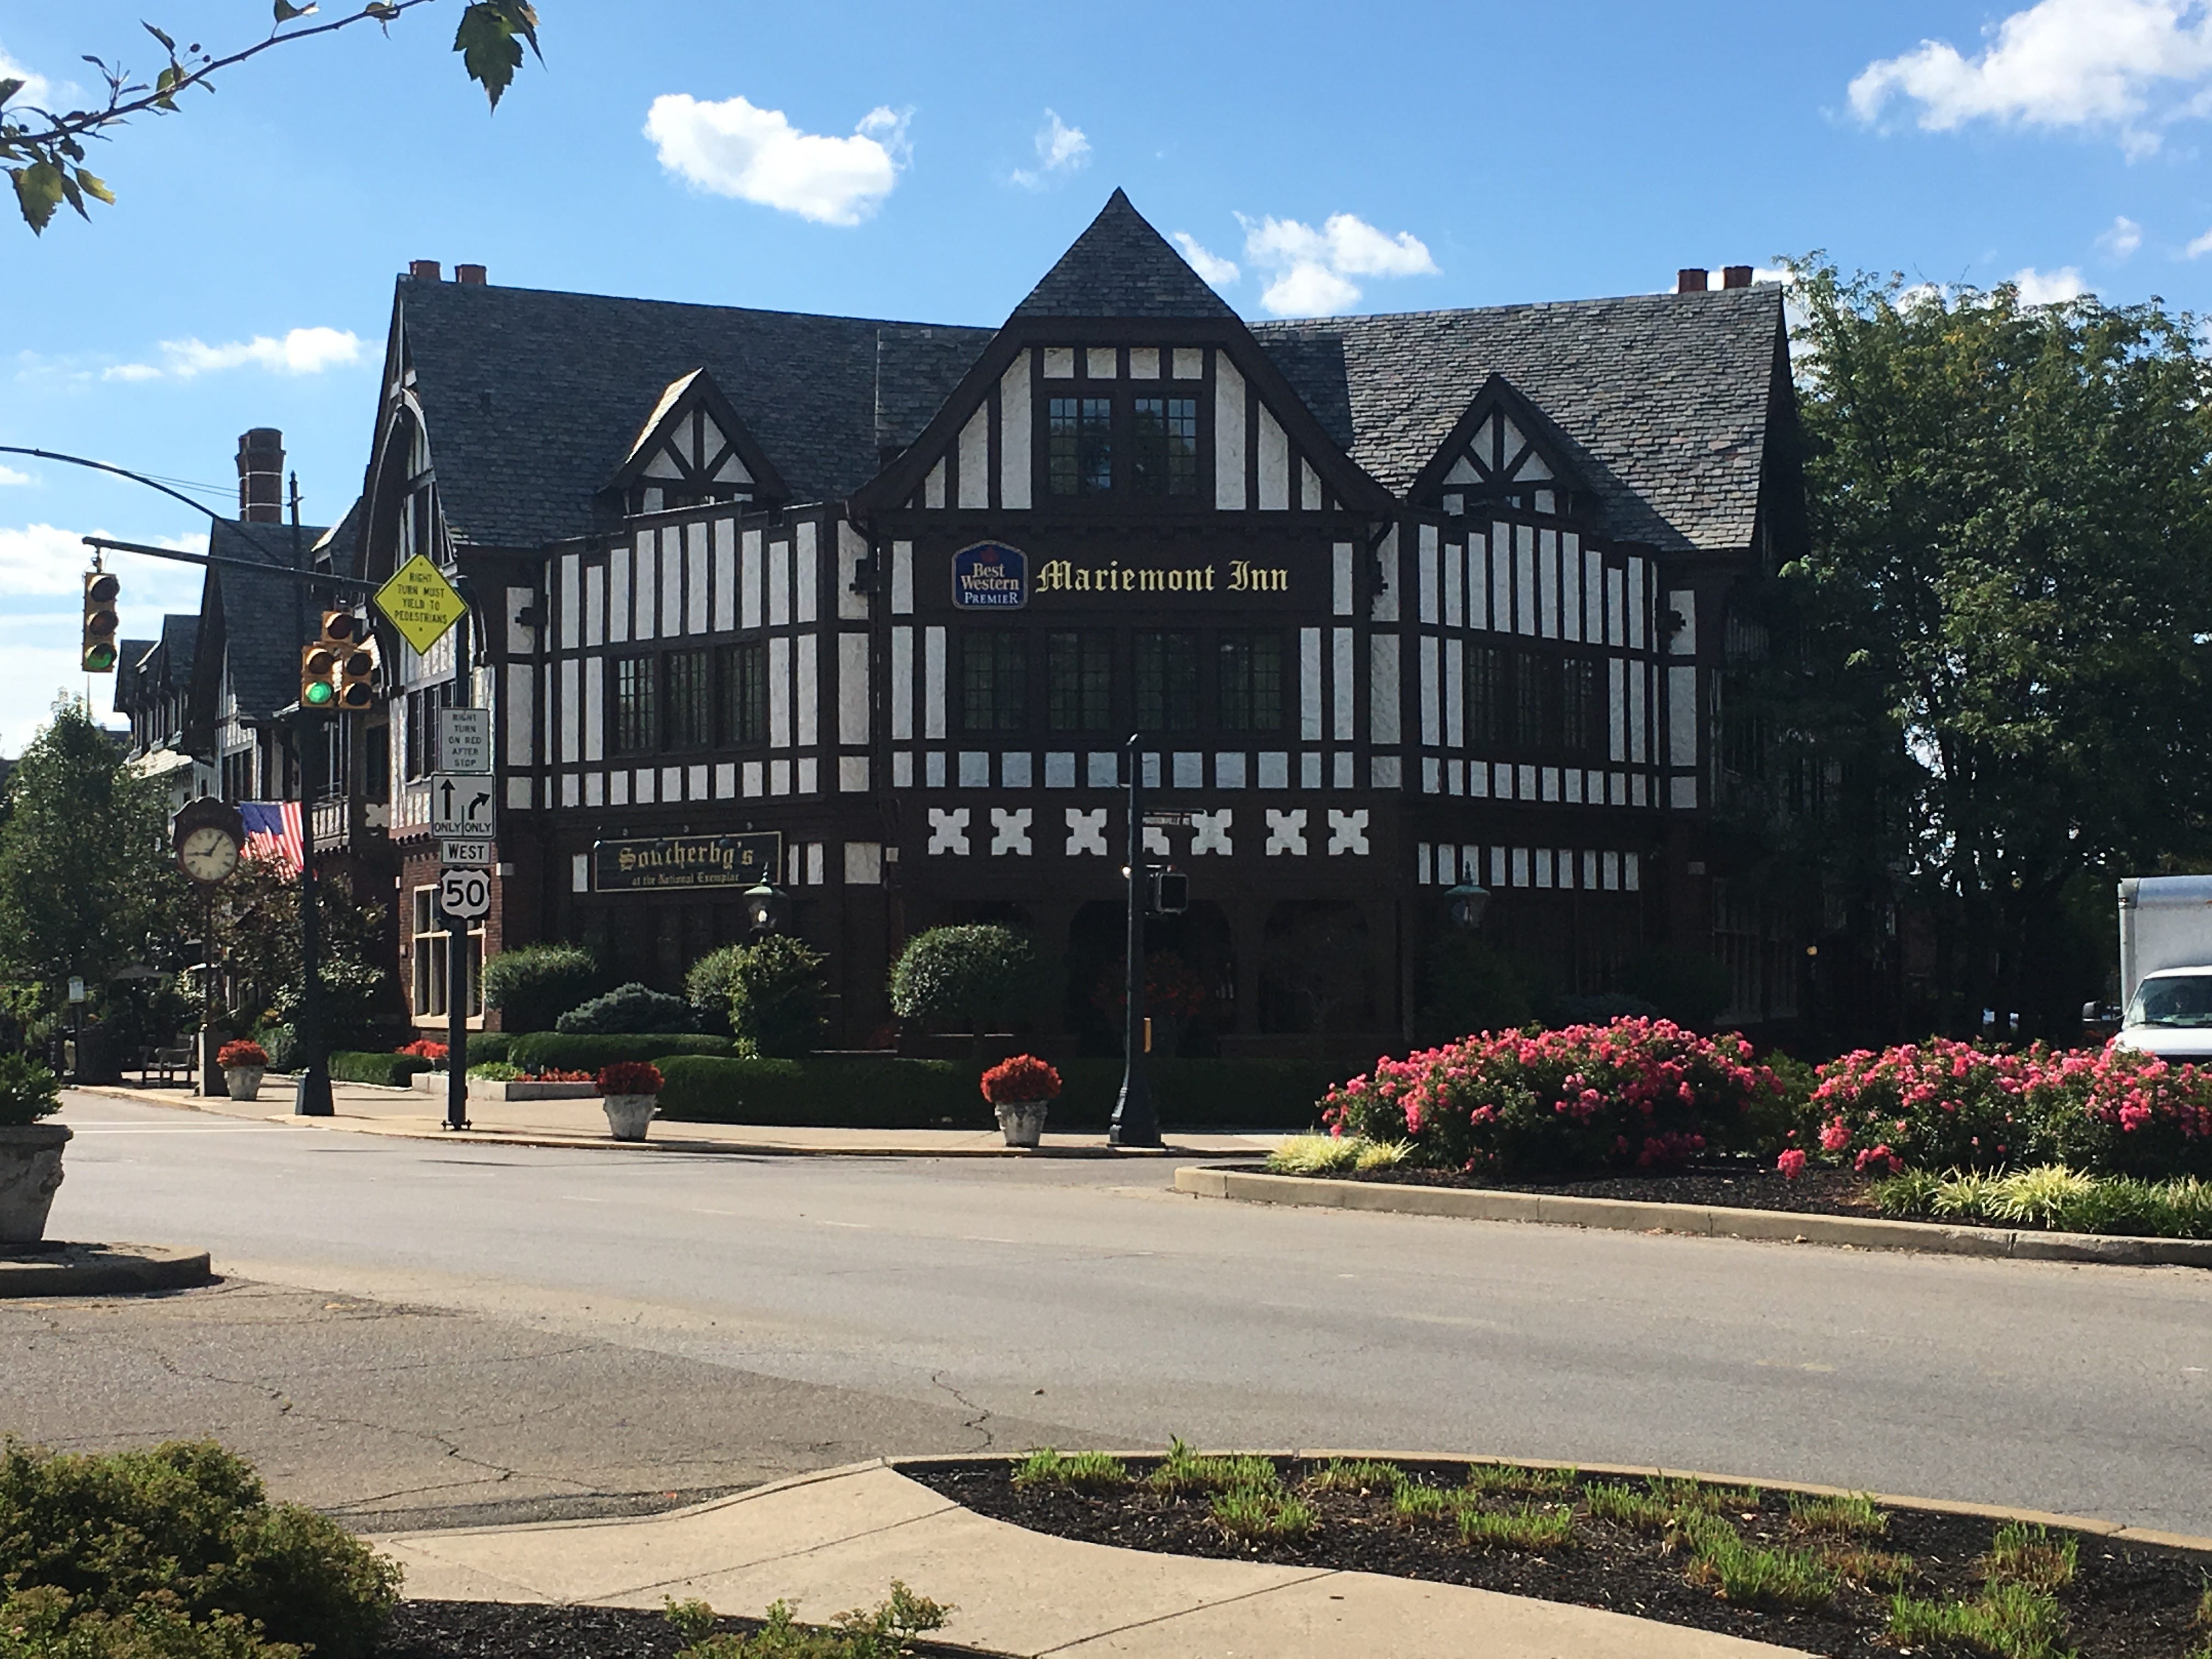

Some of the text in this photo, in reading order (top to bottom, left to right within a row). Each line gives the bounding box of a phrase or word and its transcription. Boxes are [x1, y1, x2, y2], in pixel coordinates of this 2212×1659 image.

[973, 562, 1005, 578] Best
[1035, 559, 1289, 592] Mariemont Inn
[409, 572, 432, 583] RIGHT
[961, 575, 1020, 590] Western
[397, 584, 445, 598] TURN MUST
[964, 592, 1019, 604] PREMIER
[402, 598, 440, 611] YIELD TO
[394, 610, 448, 624] PEDESTRIANS
[435, 822, 461, 832] ONLY
[465, 822, 492, 832] ONLY
[449, 843, 485, 860] WEST
[643, 874, 656, 885] the
[447, 879, 485, 907] 50
